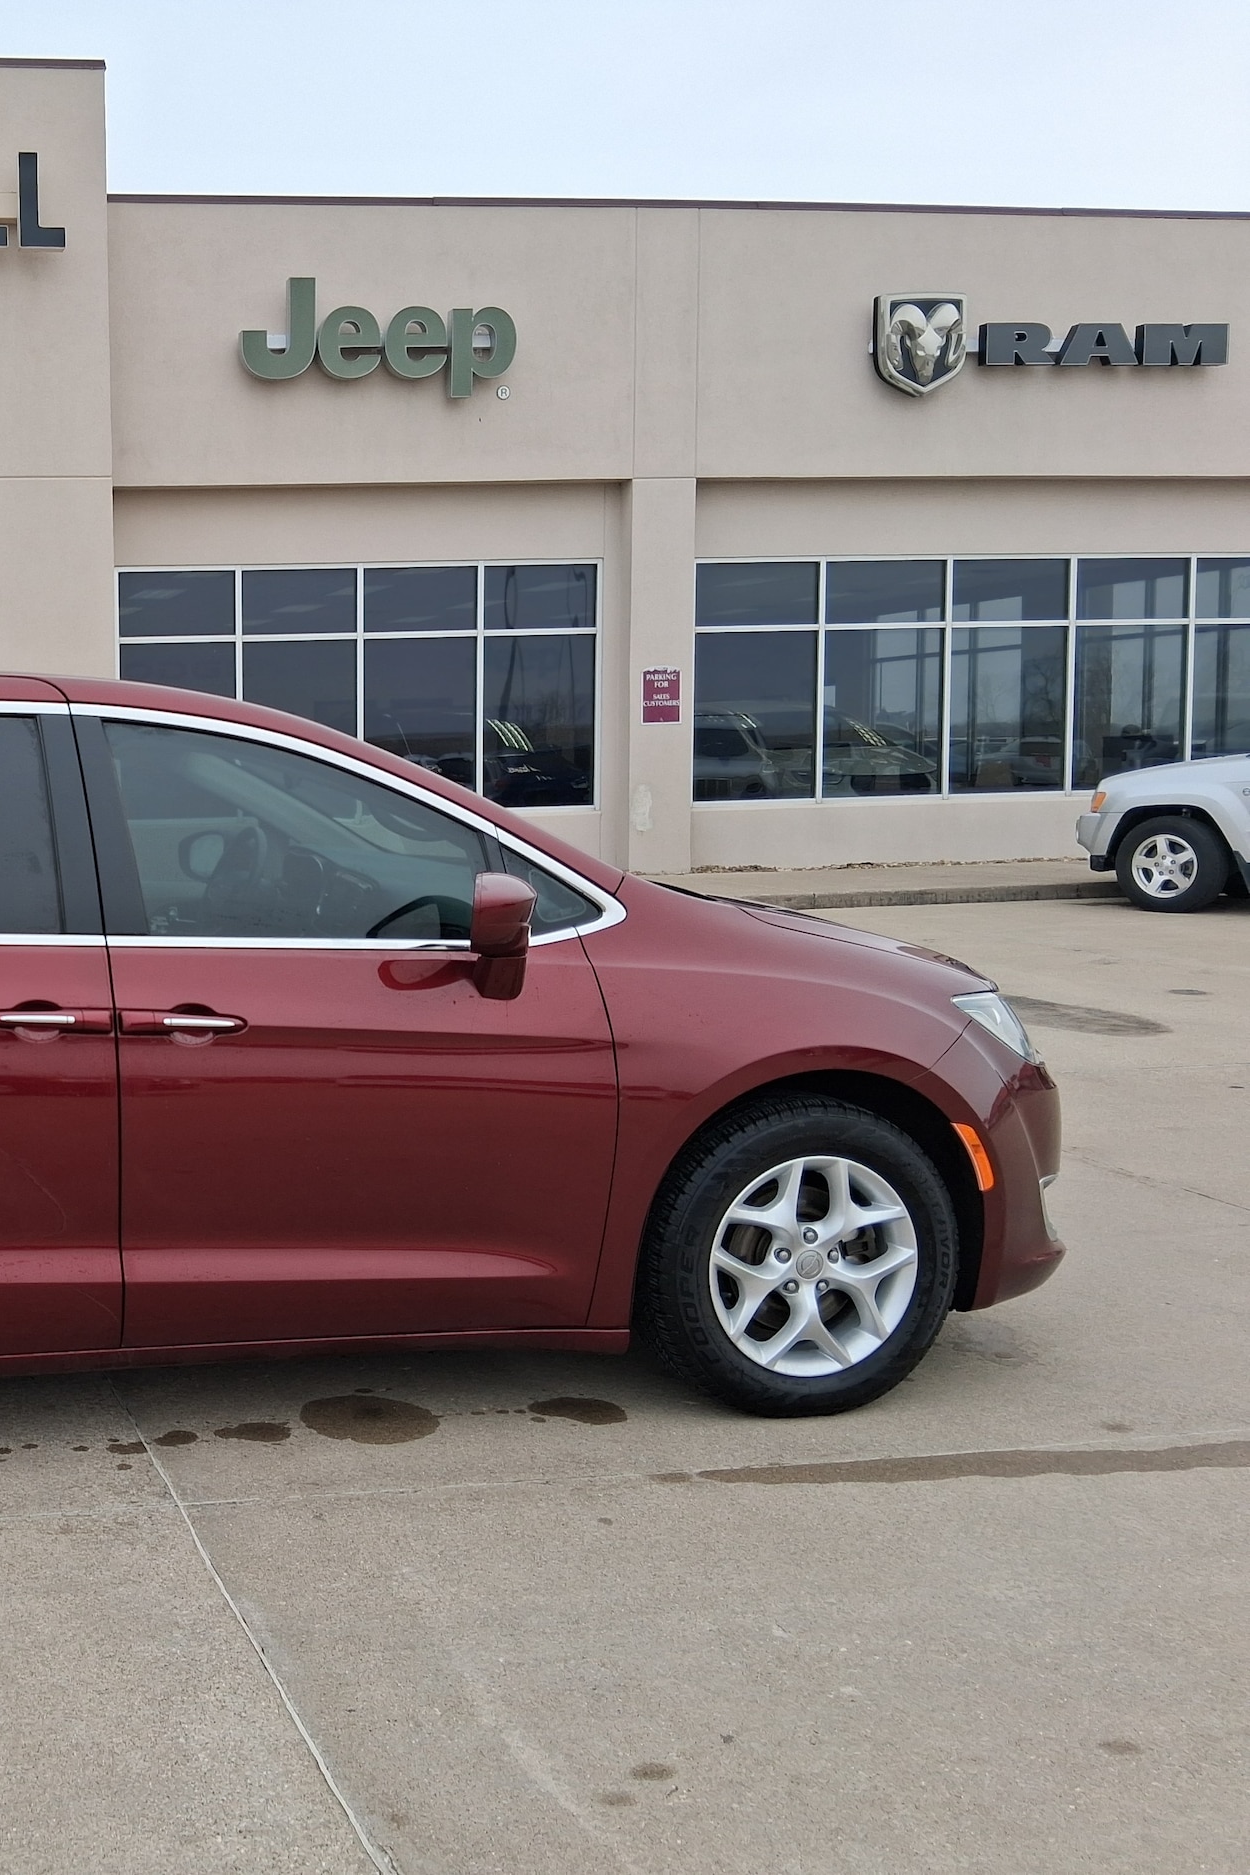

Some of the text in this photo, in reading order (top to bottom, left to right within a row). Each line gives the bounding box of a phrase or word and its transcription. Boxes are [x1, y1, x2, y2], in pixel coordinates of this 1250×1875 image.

[238, 277, 517, 399] Jeep
[978, 322, 1231, 366] RAM
[646, 673, 677, 681] PARKING
